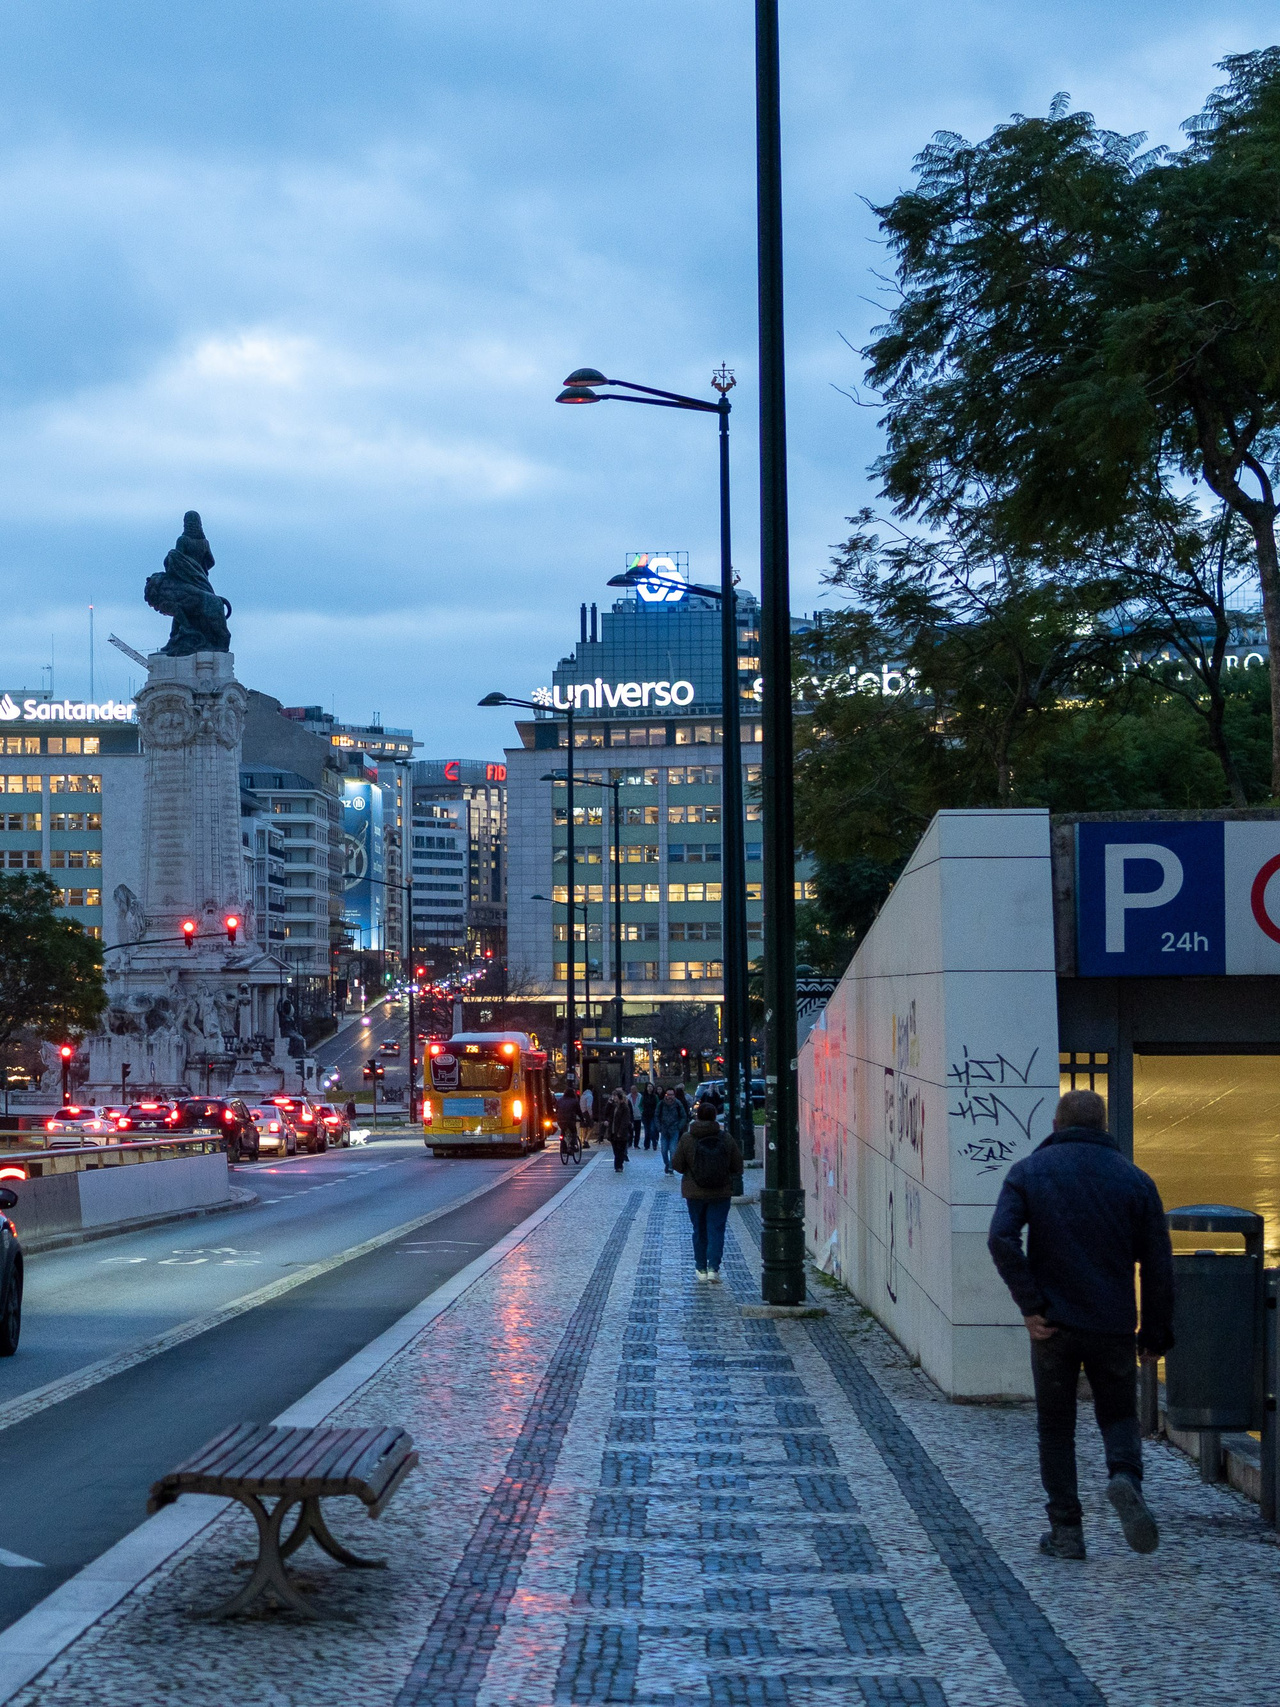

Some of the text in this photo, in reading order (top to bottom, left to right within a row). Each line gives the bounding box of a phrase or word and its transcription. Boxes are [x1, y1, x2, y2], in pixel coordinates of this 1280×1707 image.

[553, 678, 695, 709] universo
[23, 699, 137, 720] Santander
[1105, 843, 1184, 952] P
[1161, 931, 1209, 952] 24h
